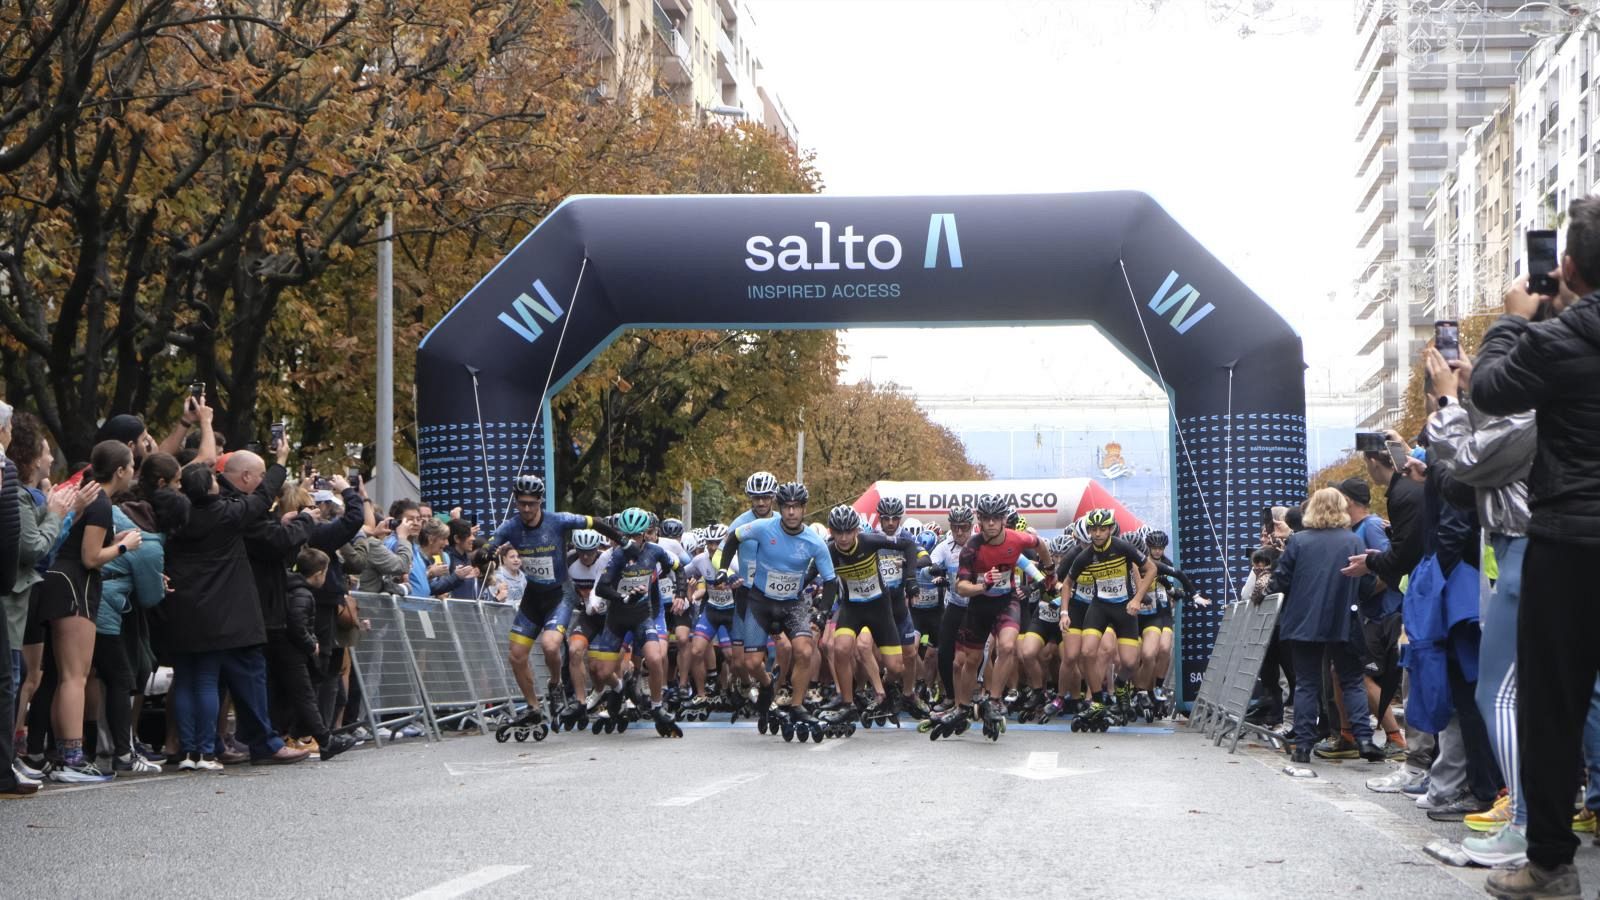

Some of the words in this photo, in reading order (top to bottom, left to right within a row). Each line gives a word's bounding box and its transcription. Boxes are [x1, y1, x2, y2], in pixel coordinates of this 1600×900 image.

[745, 222, 903, 271] salto
[748, 284, 826, 299] INSPIRED
[832, 283, 901, 298] ACCESS
[905, 493, 926, 509] EL
[929, 492, 992, 509] DIARI
[769, 582, 797, 592] 4002
[1101, 584, 1123, 594] 4267
